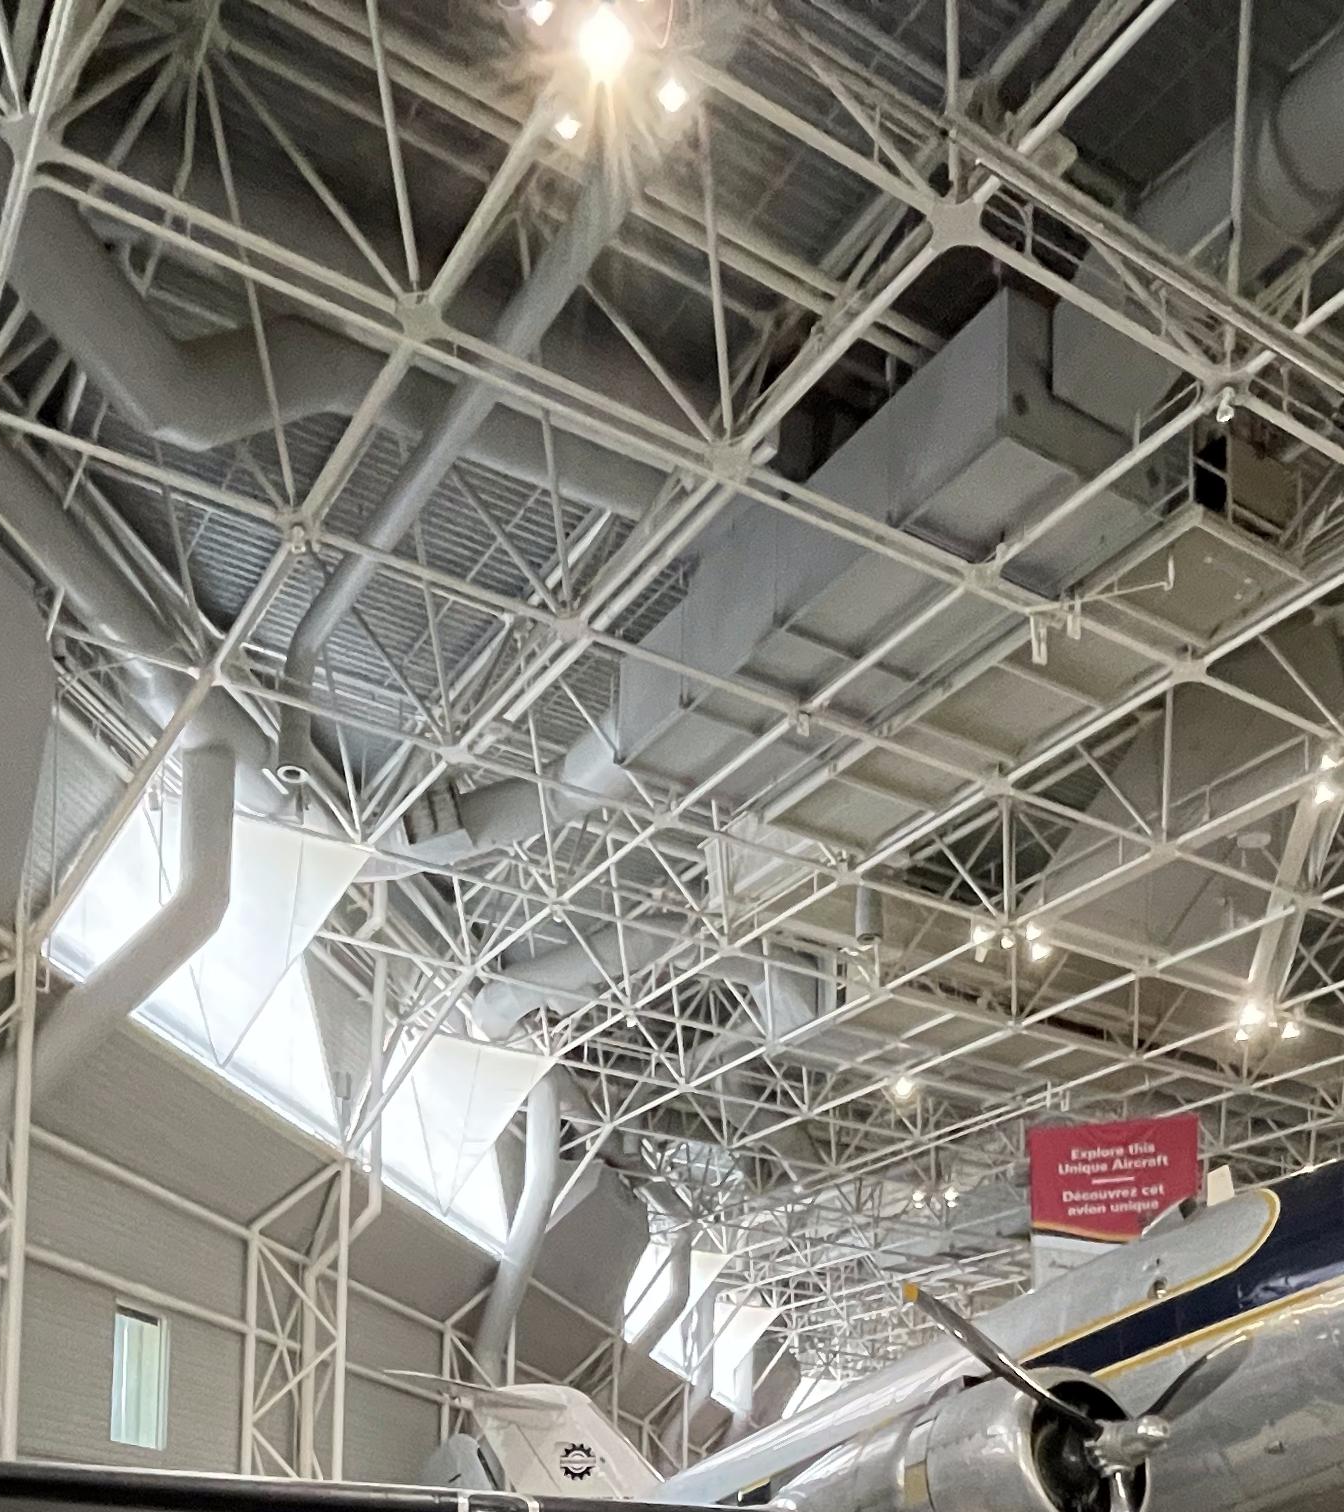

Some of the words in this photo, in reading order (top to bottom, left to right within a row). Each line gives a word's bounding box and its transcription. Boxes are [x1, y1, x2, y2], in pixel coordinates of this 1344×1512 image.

[1071, 1145, 1124, 1161] Explore
[1128, 1142, 1156, 1155] this
[1058, 1161, 1108, 1176] Unique
[1112, 1155, 1169, 1171] Aircraft
[1062, 1185, 1138, 1202] Découvrez
[1142, 1184, 1165, 1196] cet
[1067, 1201, 1106, 1216] avion
[1110, 1199, 1159, 1214] unique
